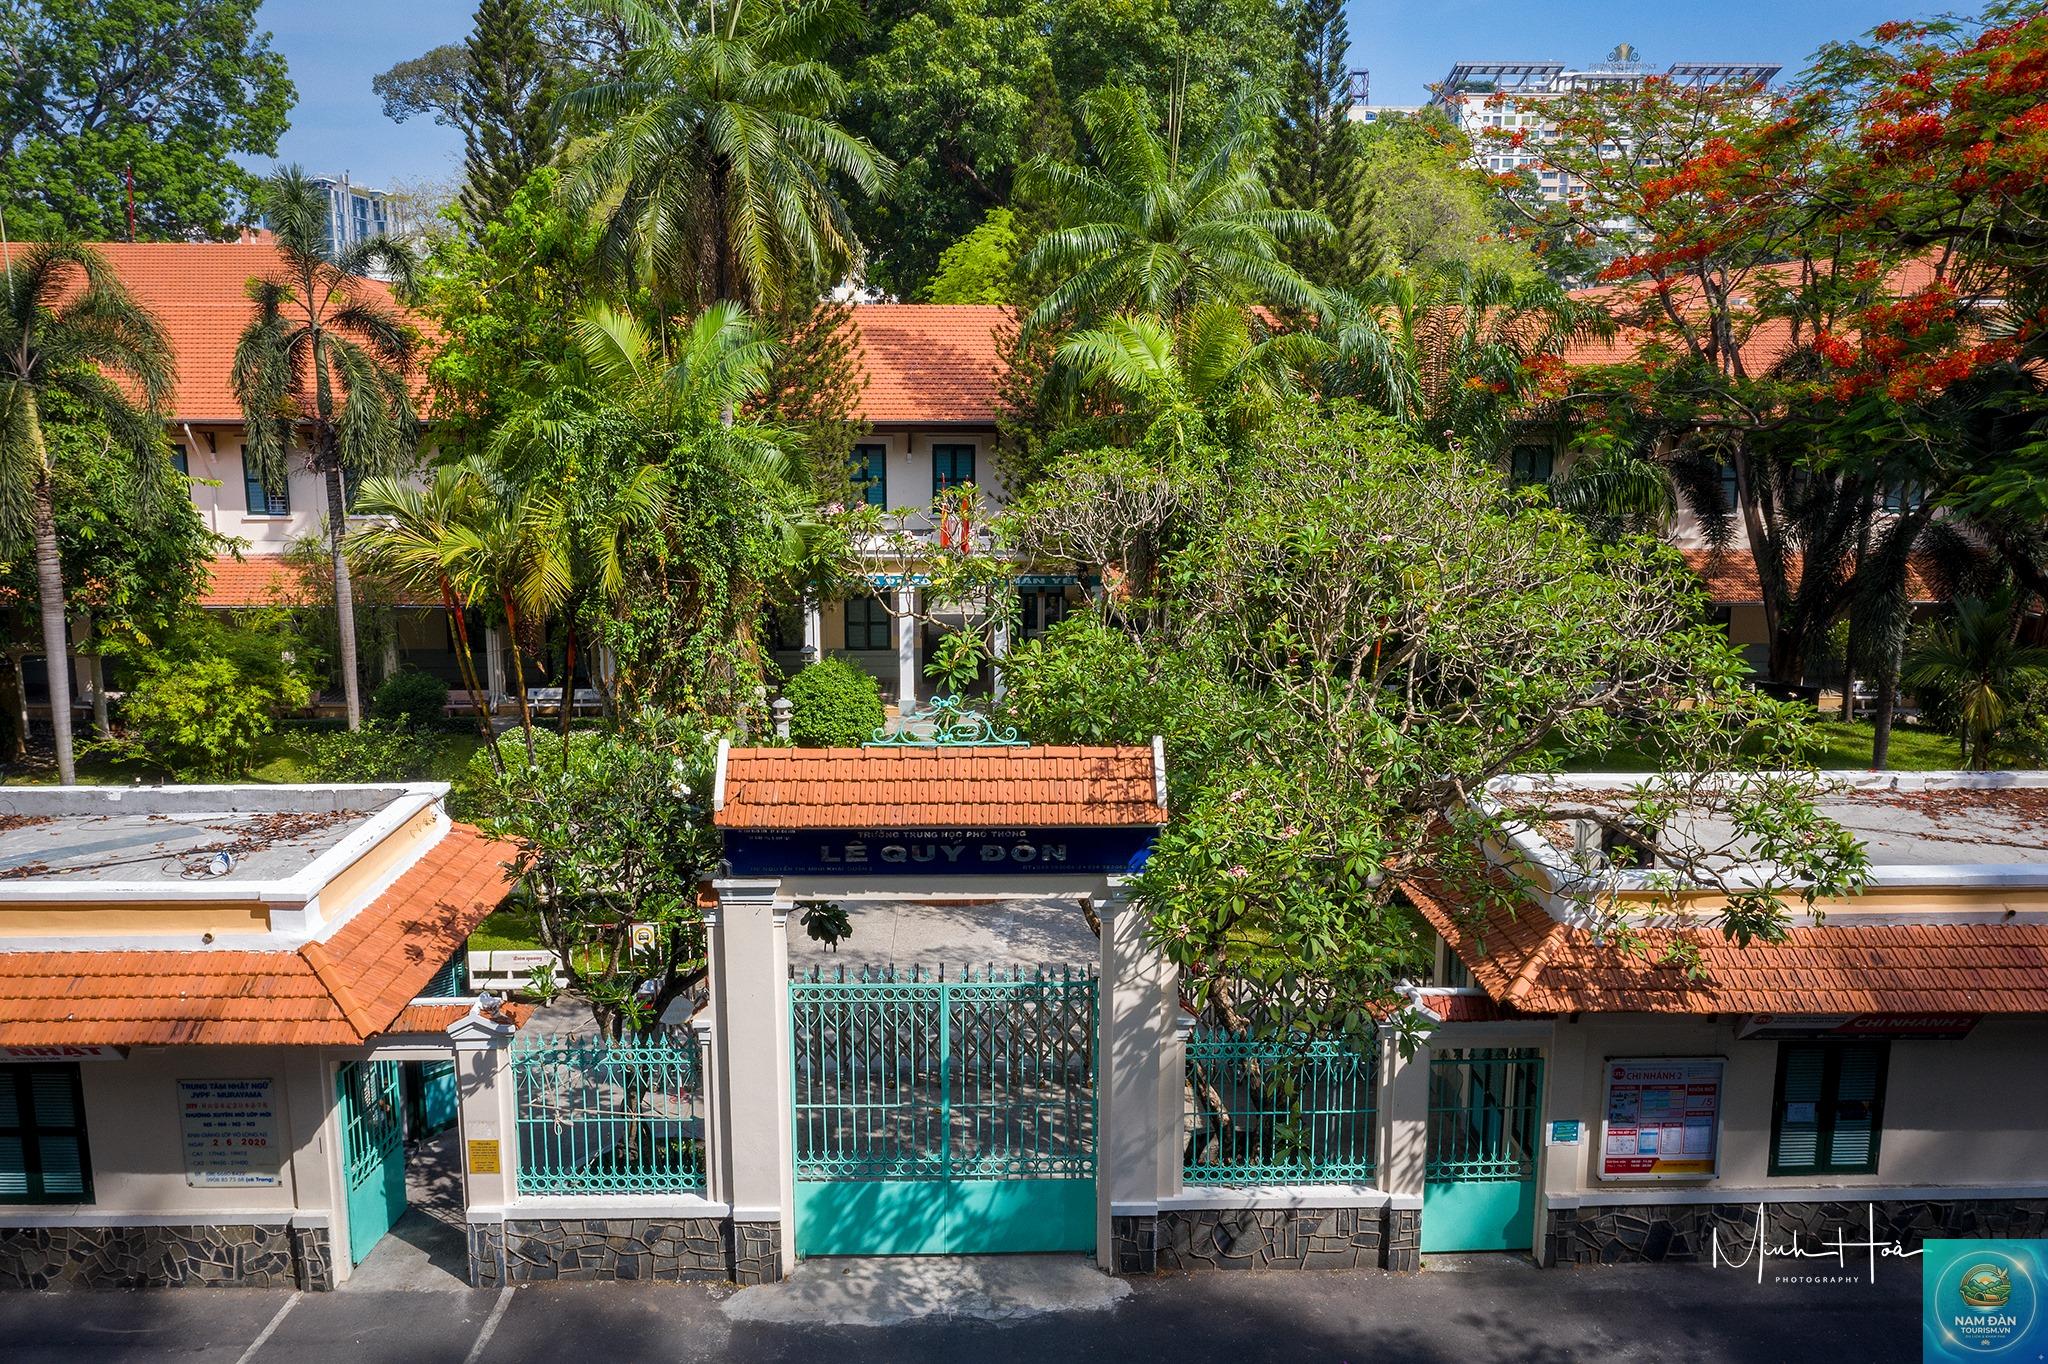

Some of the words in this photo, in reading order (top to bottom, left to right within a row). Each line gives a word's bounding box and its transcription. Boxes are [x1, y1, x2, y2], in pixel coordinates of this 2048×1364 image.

[820, 840, 869, 863] LÊ
[979, 838, 1067, 862] ĐÔN
[1854, 1017, 1888, 1028] CHI
[1957, 1018, 1971, 1027] 2
[1627, 1071, 1641, 1080] CHI
[241, 1138, 267, 1146] 2020
